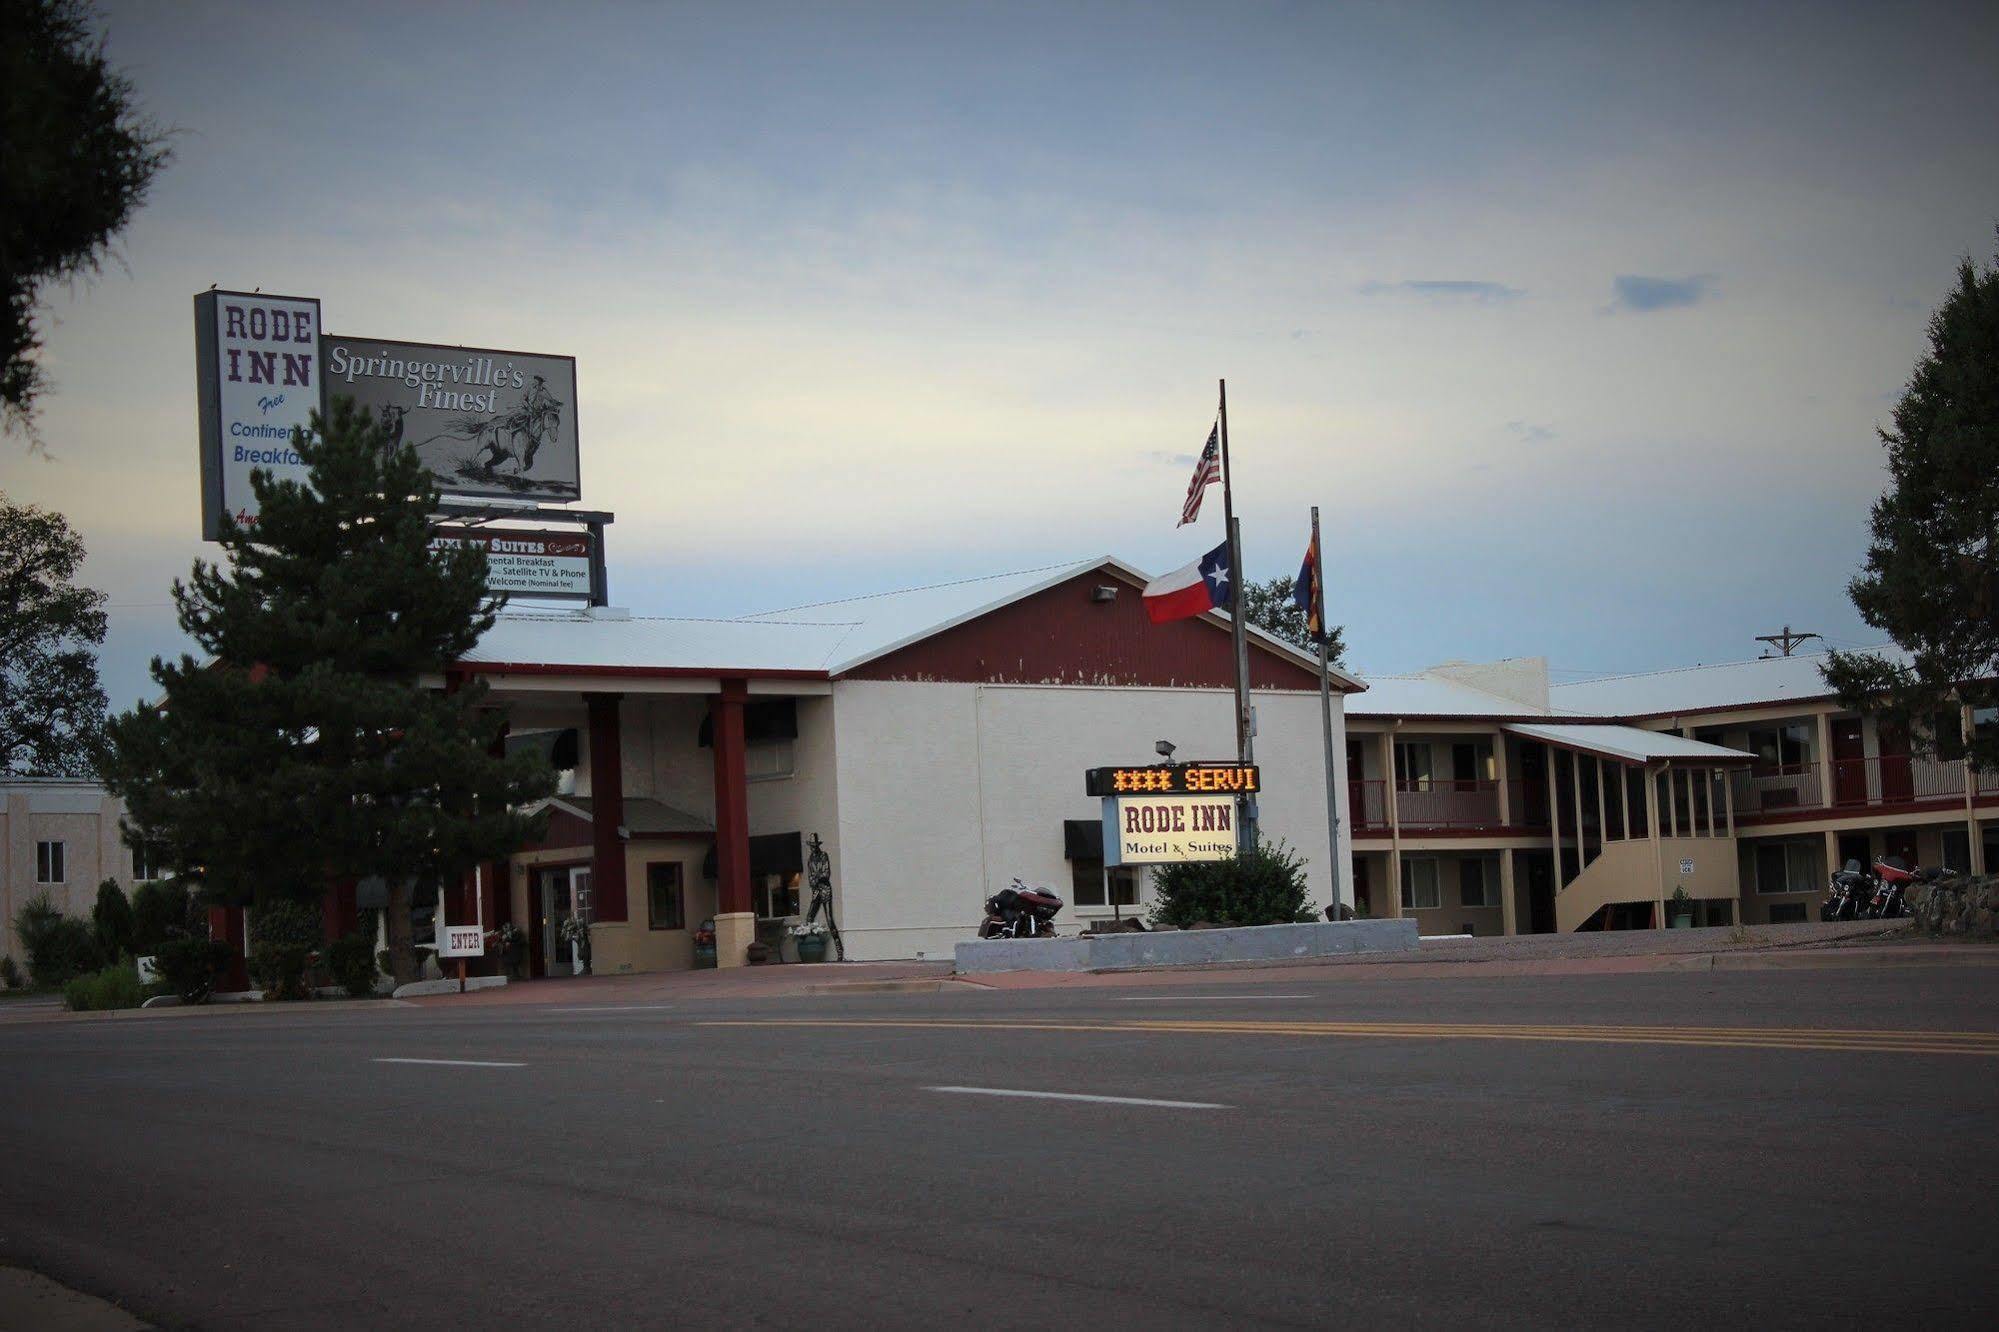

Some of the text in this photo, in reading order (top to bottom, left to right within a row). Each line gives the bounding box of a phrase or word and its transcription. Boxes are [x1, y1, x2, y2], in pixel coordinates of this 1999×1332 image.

[225, 305, 312, 344] RODE
[227, 348, 312, 388] INN
[329, 346, 527, 389] Springerville's
[257, 394, 285, 415] Free
[417, 381, 497, 414] Finest
[234, 445, 309, 465] Breakfa
[491, 537, 545, 554] SUITES
[502, 566, 586, 578] Satellite TV & Phone
[516, 557, 555, 567] Breakfast
[487, 577, 527, 587] Welcome
[1184, 768, 1256, 791] SERVI
[1125, 804, 1232, 834] RODE INN
[1126, 842, 1167, 854] Motel
[1188, 841, 1233, 853] Suites
[451, 932, 480, 949] ENTER
